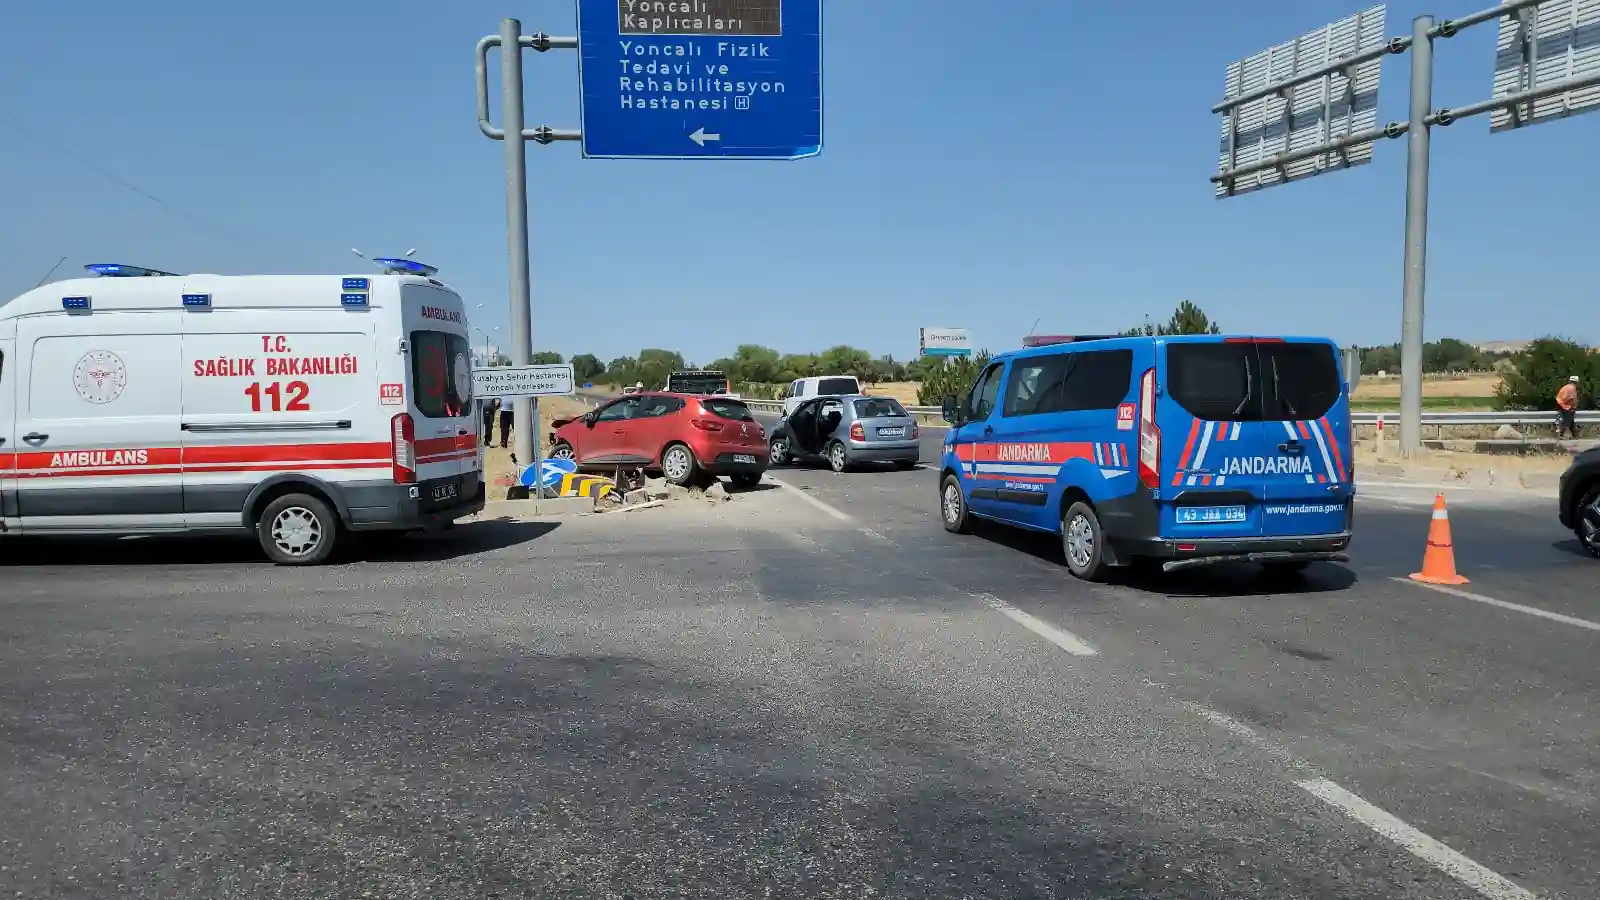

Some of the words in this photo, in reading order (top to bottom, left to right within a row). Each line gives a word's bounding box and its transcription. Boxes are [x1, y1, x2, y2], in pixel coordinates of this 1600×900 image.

[624, 0, 706, 13] Yoncalı
[623, 13, 742, 33] Kaplıcaları
[619, 40, 701, 56] Yoncalı
[717, 42, 770, 57] Fizik
[619, 59, 691, 75] Tedavi
[705, 64, 729, 75] ve
[619, 76, 785, 96] Rehabilitasyon
[620, 95, 727, 110] Hastanesi
[421, 305, 462, 325] AMBULANS
[262, 335, 292, 353] T.C.
[193, 356, 255, 377] SAĞLIK
[266, 353, 358, 376] BAKANLIĞI
[244, 380, 311, 412] 112
[382, 385, 400, 397] 112
[1120, 406, 1133, 419] 112
[50, 449, 148, 467] AMBULANS
[997, 443, 1051, 461] JANDARMA
[1219, 456, 1313, 475] JANDARMA
[1183, 508, 1197, 521] 43
[1202, 507, 1221, 520] JAA
[1266, 504, 1344, 515] www.jandarma.gov.tr
